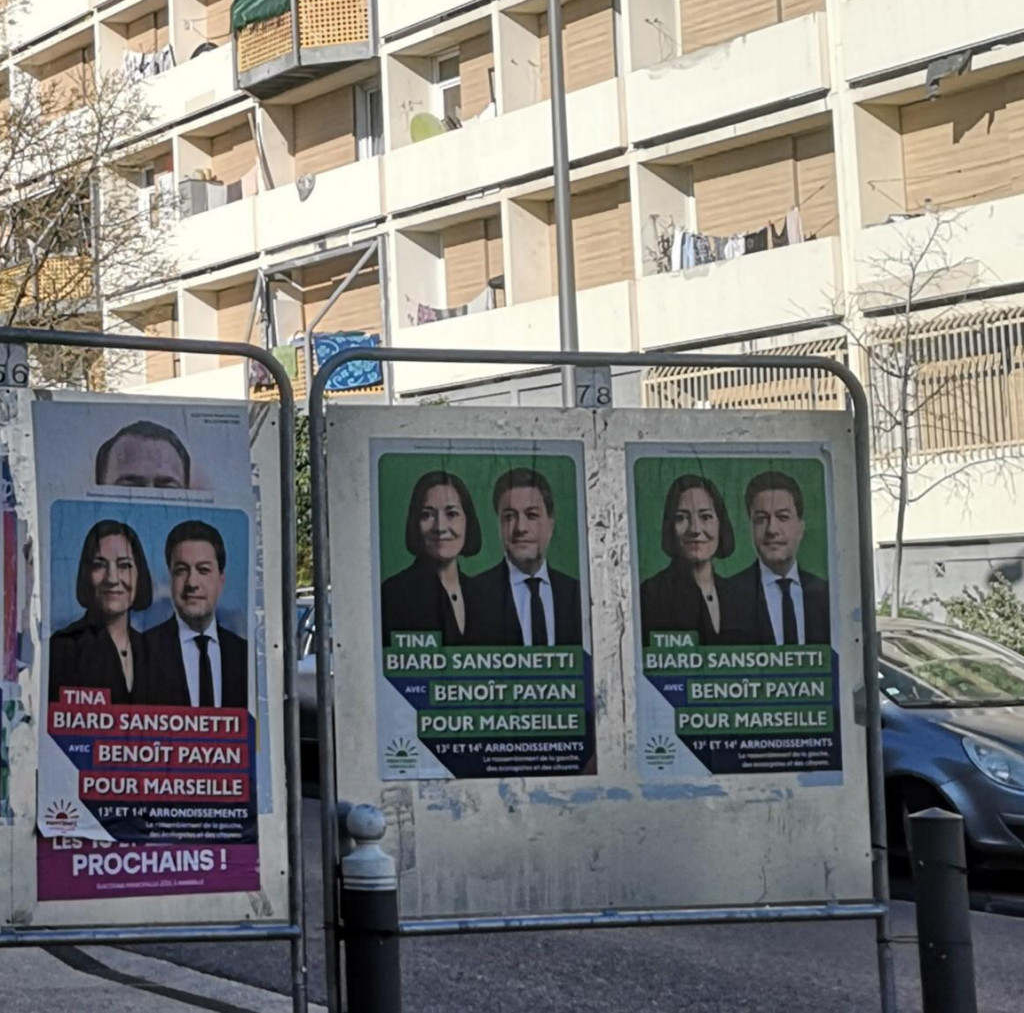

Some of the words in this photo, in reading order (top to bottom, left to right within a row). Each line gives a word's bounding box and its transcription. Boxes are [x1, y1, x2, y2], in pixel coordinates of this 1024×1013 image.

[395, 634, 437, 648] TINA
[654, 634, 694, 647] TINA
[386, 654, 447, 670] BIARD
[452, 653, 574, 669] SANSONETTI
[646, 653, 703, 669] BIARD
[707, 651, 823, 668] SANSONETTI
[64, 690, 107, 705] TINA
[405, 686, 426, 694] AVEC
[434, 680, 508, 701] BENOÎT
[513, 683, 576, 700] PAYAN
[691, 678, 761, 699] BENOÎT
[766, 681, 825, 697] PAYAN
[53, 711, 114, 729] BIARD
[119, 714, 239, 732] SANSONETTI
[421, 715, 475, 732] POUR
[479, 714, 579, 730] MARSEILLE
[679, 713, 730, 729] POUR
[735, 711, 827, 728] MARSEILLE
[68, 744, 91, 753] AVEC
[98, 741, 173, 764] BENOÎT
[178, 747, 241, 764] PAYAN
[453, 743, 466, 753] ET
[485, 742, 584, 752] ARRONDISSEMENTS
[709, 740, 722, 750] ET
[740, 738, 833, 749] ARRONDISSEMENTS
[83, 777, 138, 794] POUR
[143, 778, 243, 796] MARSEILLE
[115, 807, 129, 817] ET
[149, 807, 248, 818] ARRONDISSEMENTS
[72, 849, 214, 876] PROCHAINS
